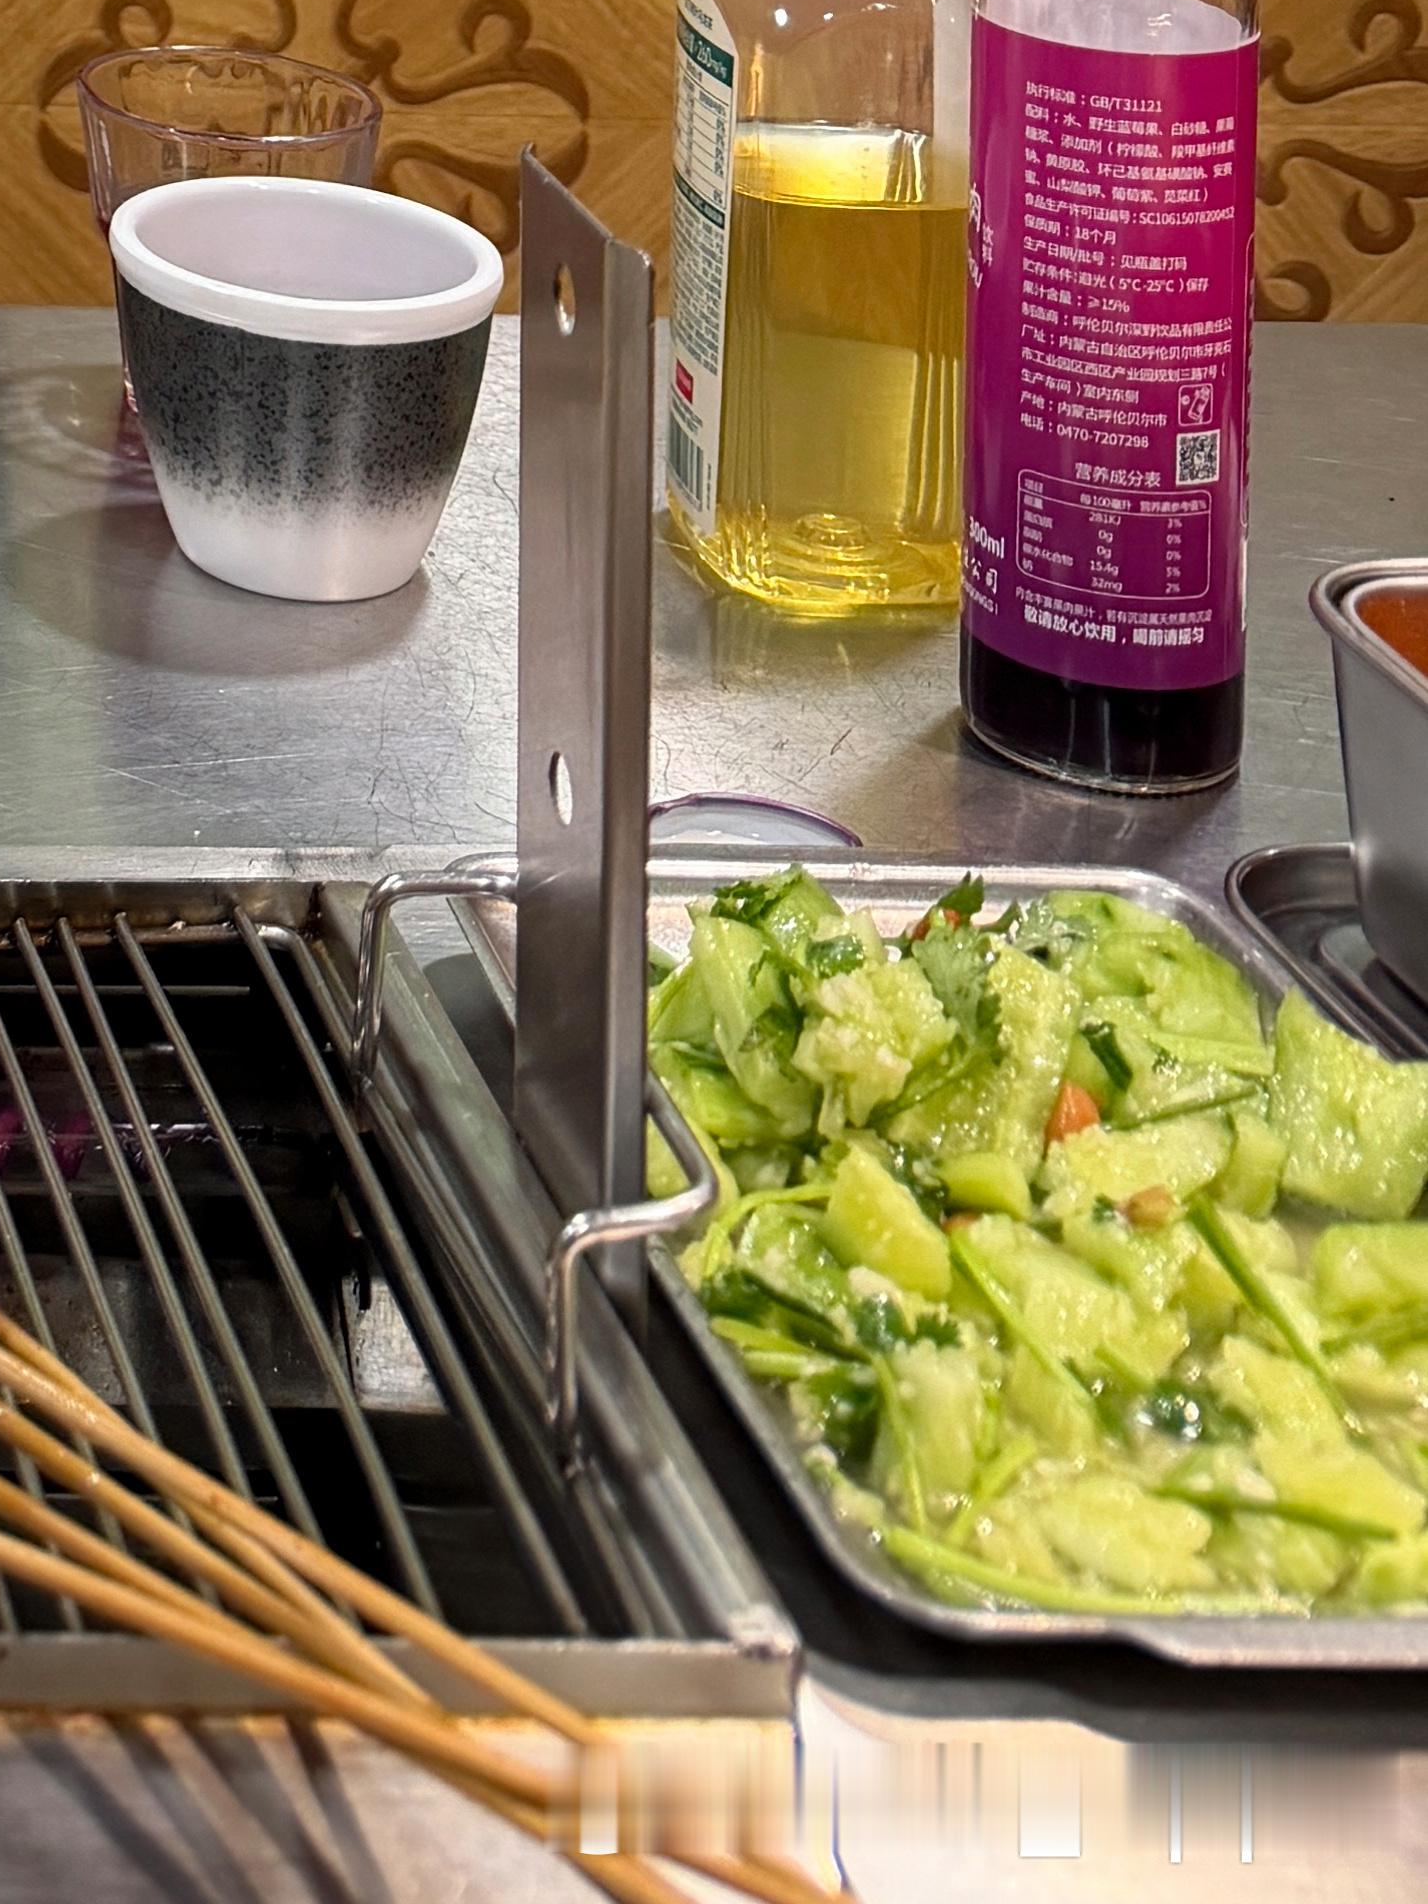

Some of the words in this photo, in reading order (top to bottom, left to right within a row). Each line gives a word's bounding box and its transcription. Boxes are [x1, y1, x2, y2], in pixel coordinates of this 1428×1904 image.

[1074, 462, 1162, 488] 营养成分表
